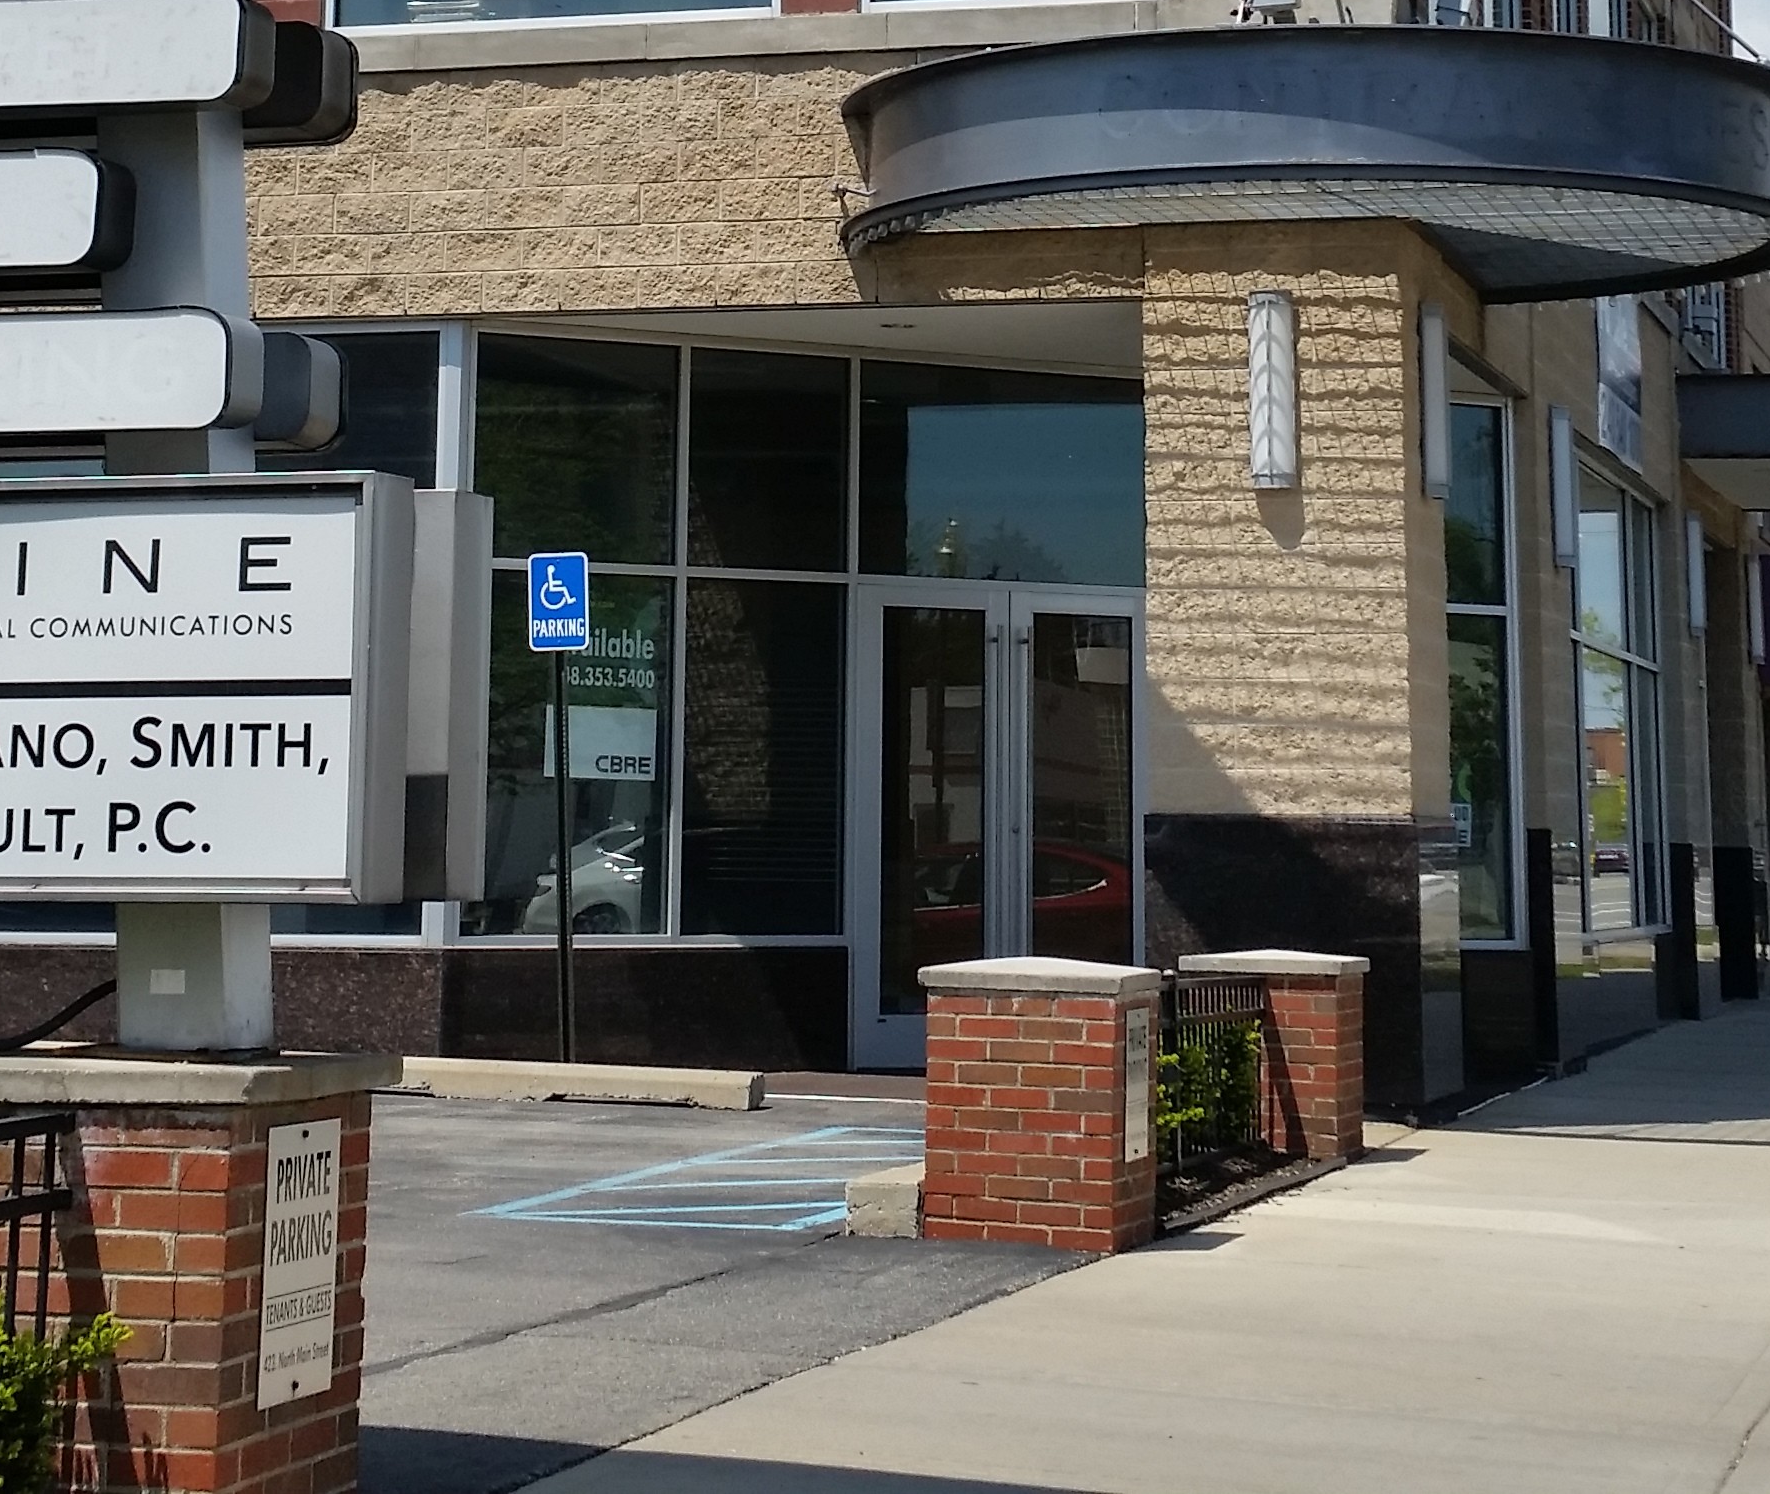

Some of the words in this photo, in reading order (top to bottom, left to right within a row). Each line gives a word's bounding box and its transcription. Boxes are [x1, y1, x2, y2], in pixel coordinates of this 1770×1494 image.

[30, 613, 292, 639] COMMUNICATIONS
[533, 618, 584, 637] PARKING
[567, 628, 655, 659] ailable
[129, 716, 329, 775] SMITH,
[595, 755, 651, 774] CBRE
[107, 800, 211, 854] P.C.
[276, 1150, 331, 1204] PRIVATE
[270, 1210, 332, 1267] PARKING
[266, 1298, 297, 1325] TENANTS
[306, 1289, 331, 1314] GUESTS
